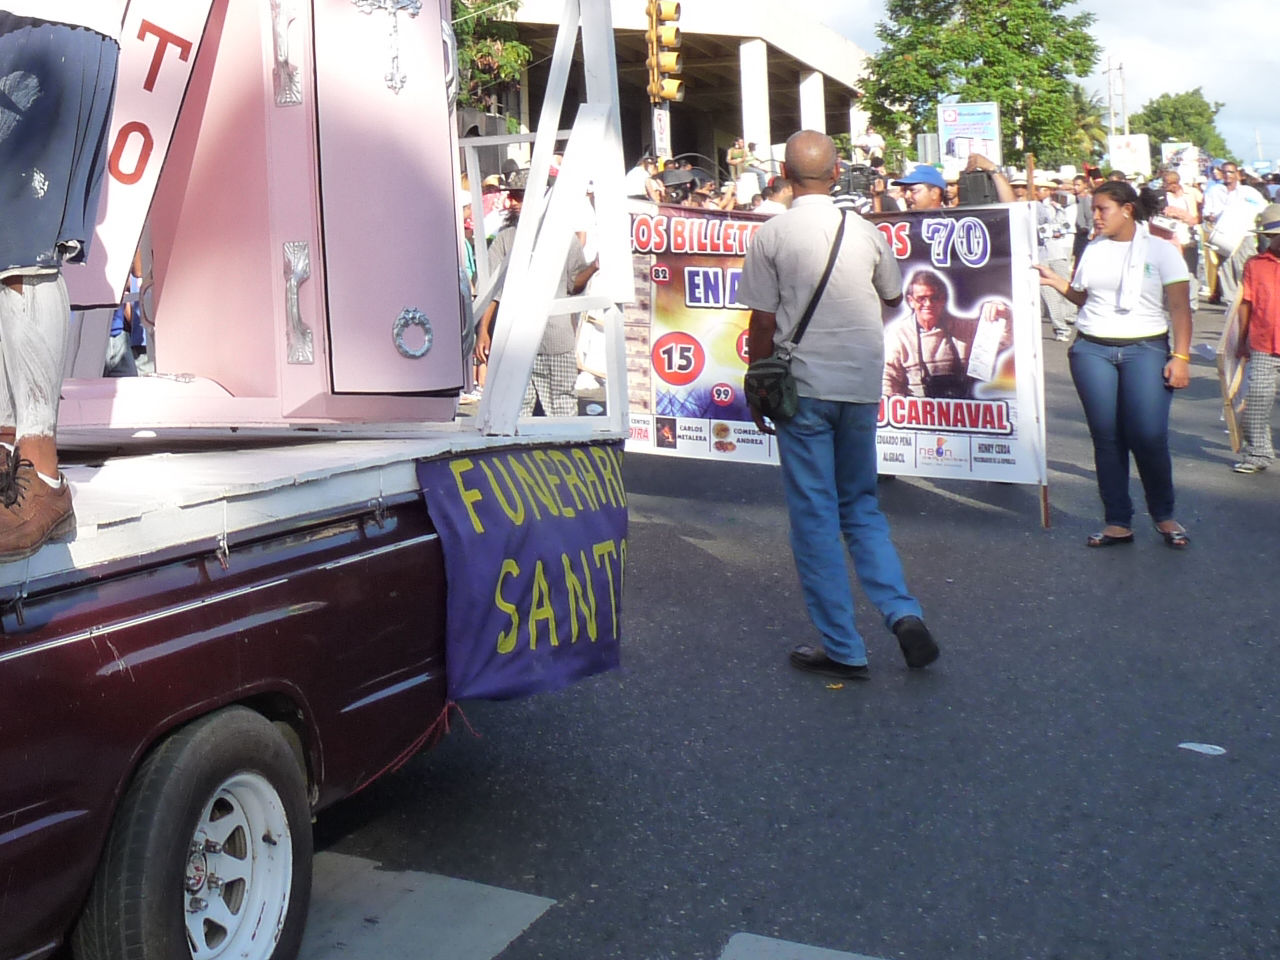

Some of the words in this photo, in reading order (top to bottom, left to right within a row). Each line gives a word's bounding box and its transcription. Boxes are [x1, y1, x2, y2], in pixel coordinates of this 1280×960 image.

[923, 217, 990, 268] 70
[653, 268, 668, 279] 82
[687, 270, 721, 304] EN
[661, 344, 693, 372] 15
[715, 388, 730, 400] 99
[891, 398, 1008, 430] CARNAVAL
[679, 425, 703, 433] CARLOS
